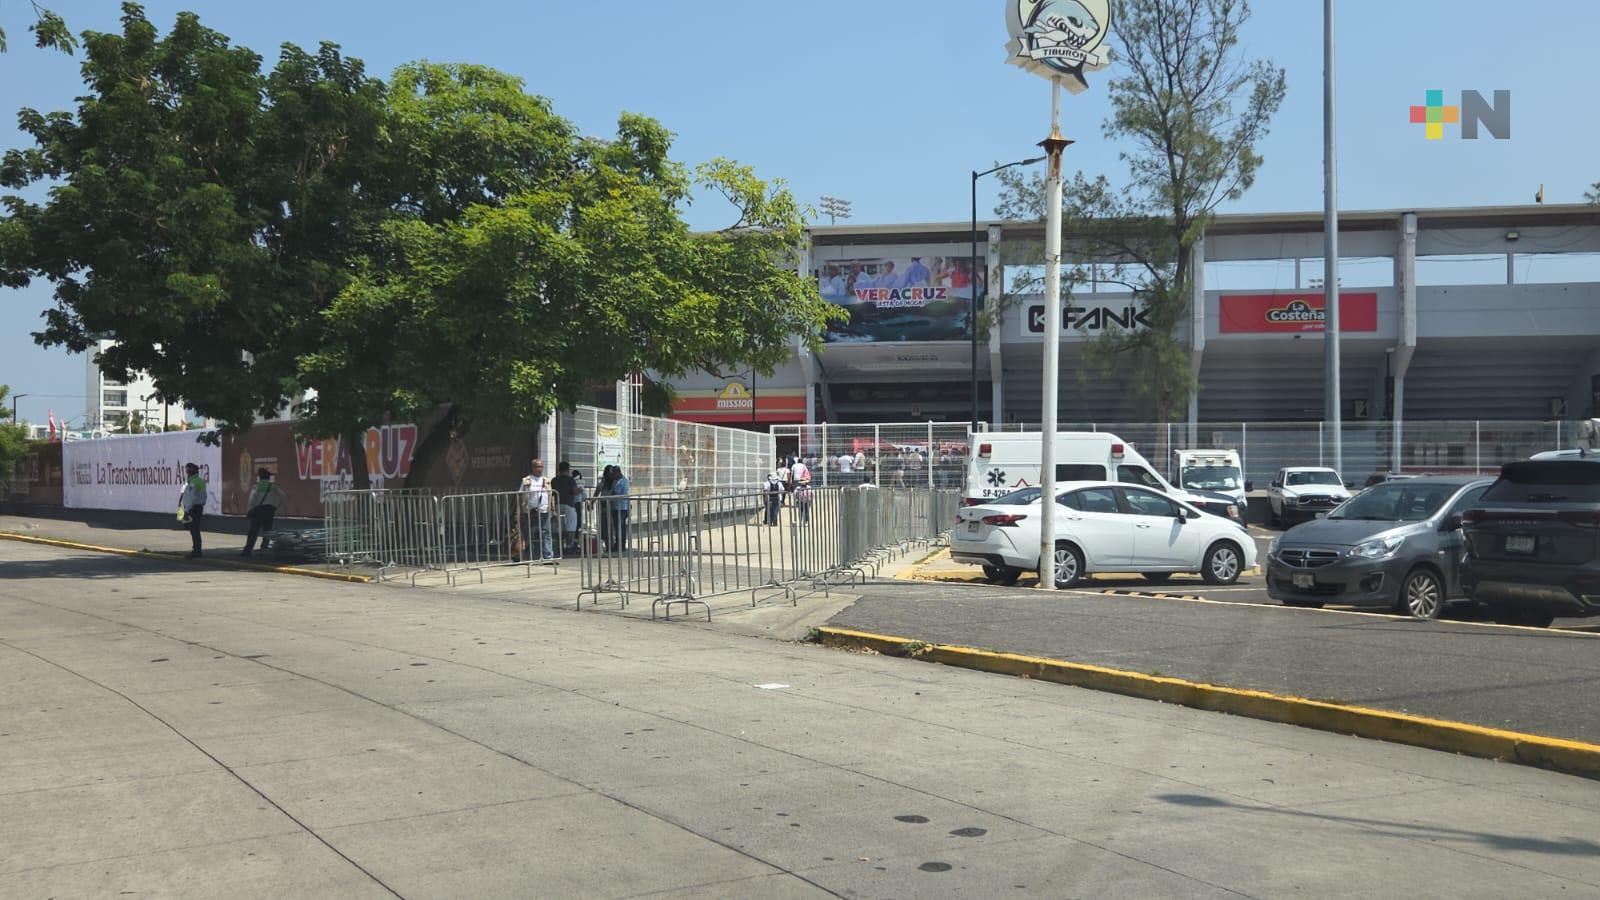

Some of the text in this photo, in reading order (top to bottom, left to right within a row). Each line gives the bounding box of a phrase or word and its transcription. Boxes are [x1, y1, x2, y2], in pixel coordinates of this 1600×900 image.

[855, 287, 947, 301] VERACRUZ
[1292, 303, 1305, 311] La
[1270, 309, 1325, 321] Costeña
[717, 399, 753, 409] mission
[295, 424, 418, 480] VERARUZ
[96, 459, 210, 486] La Transformación Ava
